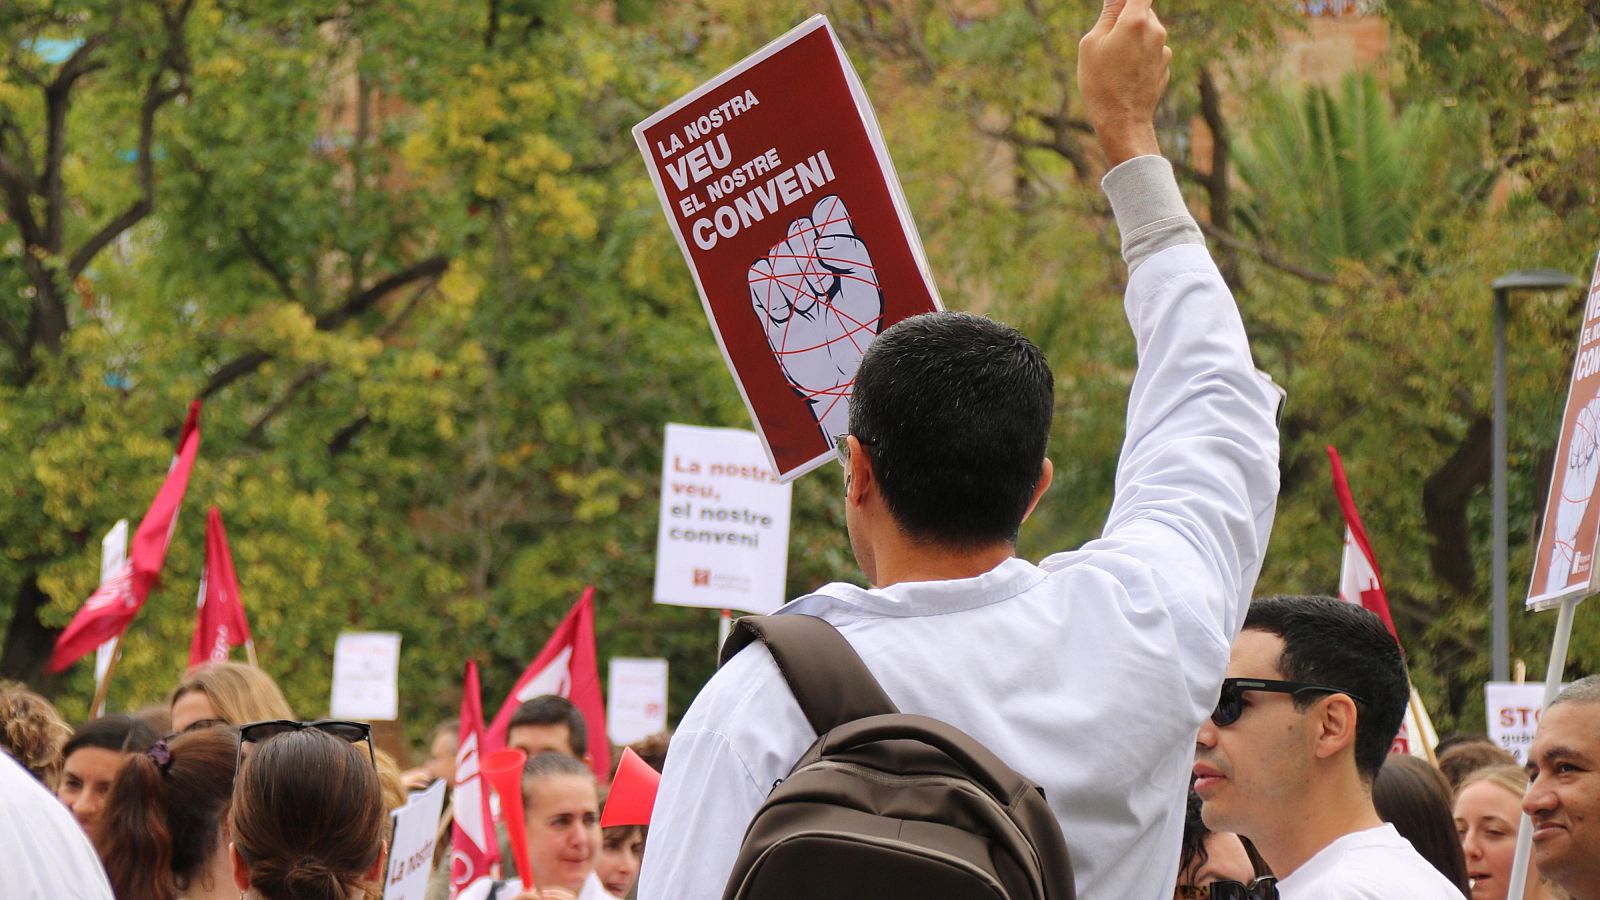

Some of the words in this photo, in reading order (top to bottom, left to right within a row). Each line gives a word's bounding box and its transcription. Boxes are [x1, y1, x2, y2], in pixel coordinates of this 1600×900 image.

[657, 134, 684, 159] LA
[684, 89, 759, 143] NOSTRA
[665, 133, 732, 191] VEU
[679, 194, 706, 218] EL
[706, 148, 782, 201] NOSTRE
[692, 150, 836, 251] CONVENI
[674, 456, 700, 473] La
[672, 482, 721, 501] veu,
[671, 504, 691, 518] el
[700, 507, 772, 527] nostre
[669, 527, 759, 548] conveni
